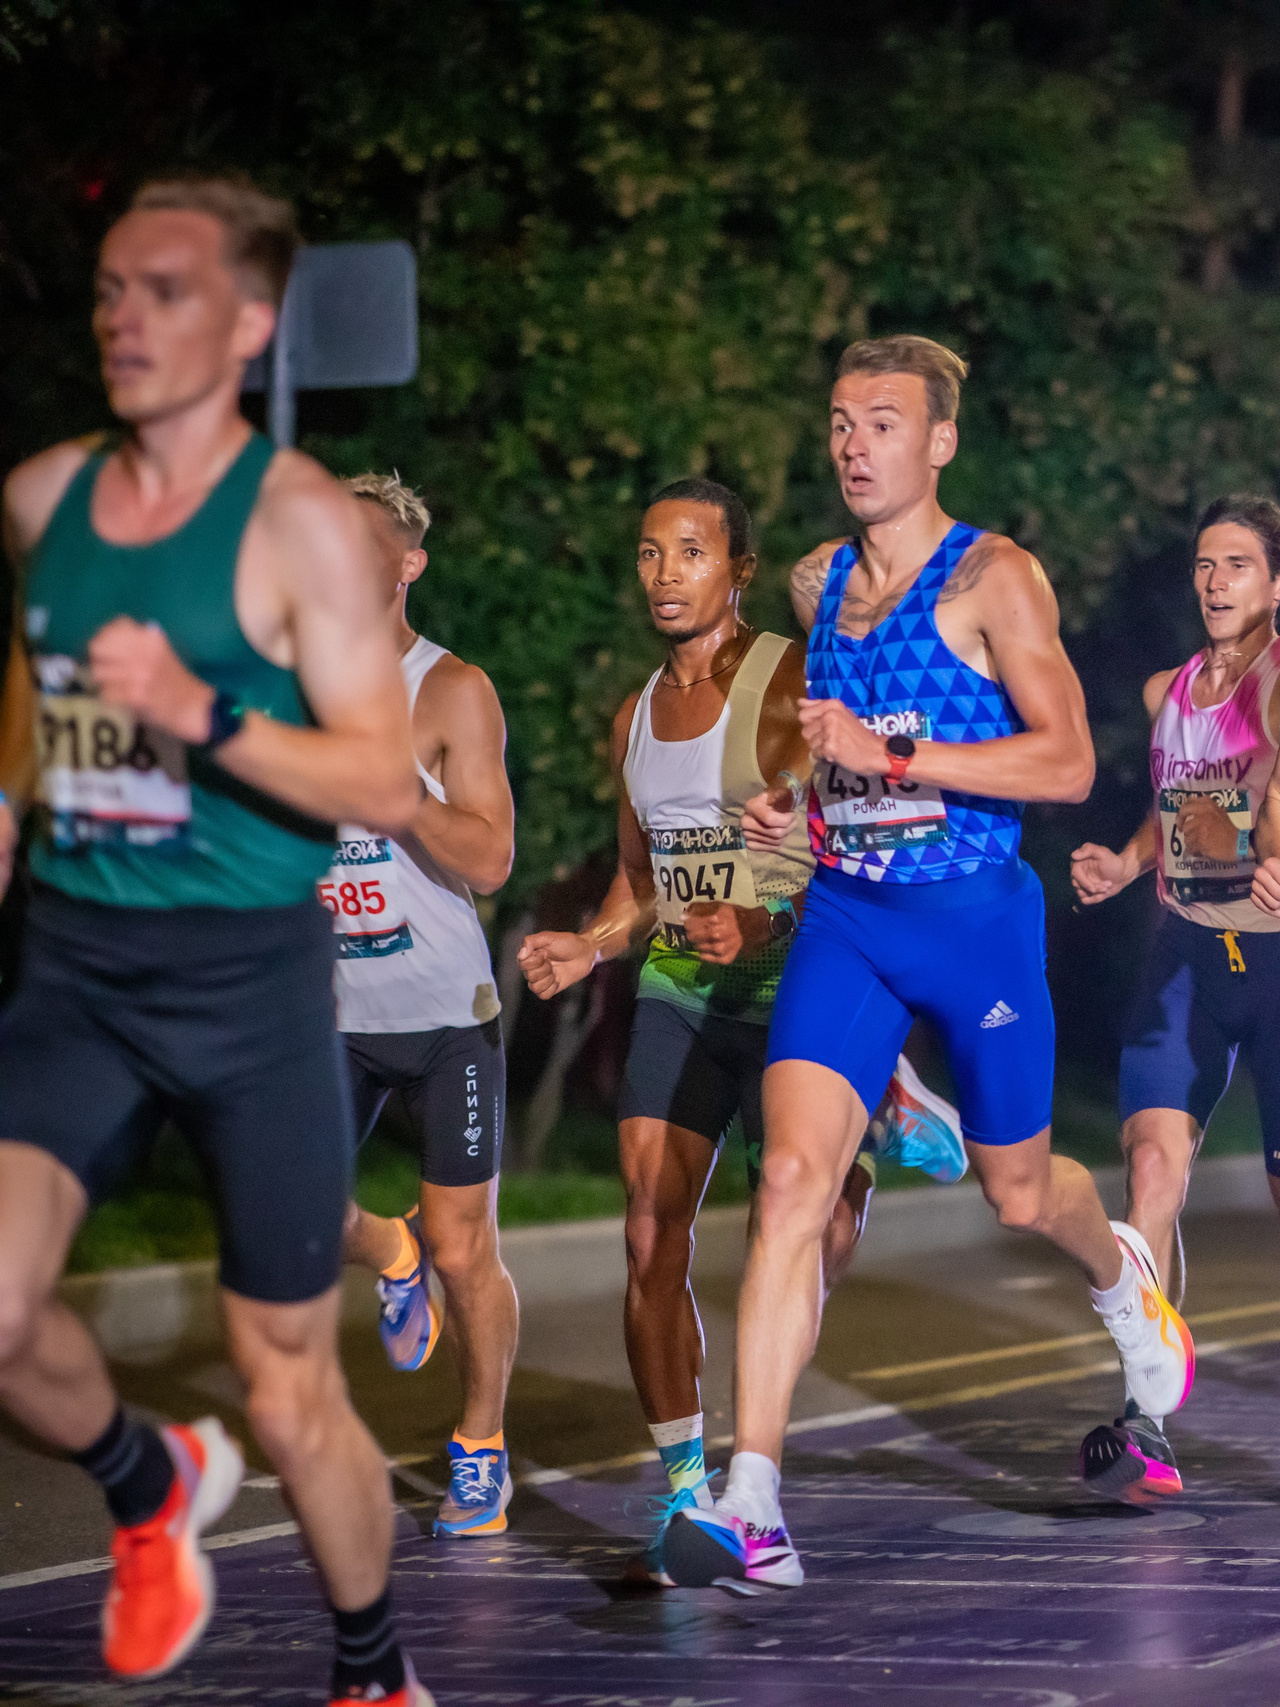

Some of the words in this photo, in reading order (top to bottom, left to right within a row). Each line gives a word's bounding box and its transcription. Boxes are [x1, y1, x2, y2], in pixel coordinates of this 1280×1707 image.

[853, 801, 897, 814] РОМАН
[659, 861, 735, 902] 9047
[980, 1012, 1020, 1029] adidas
